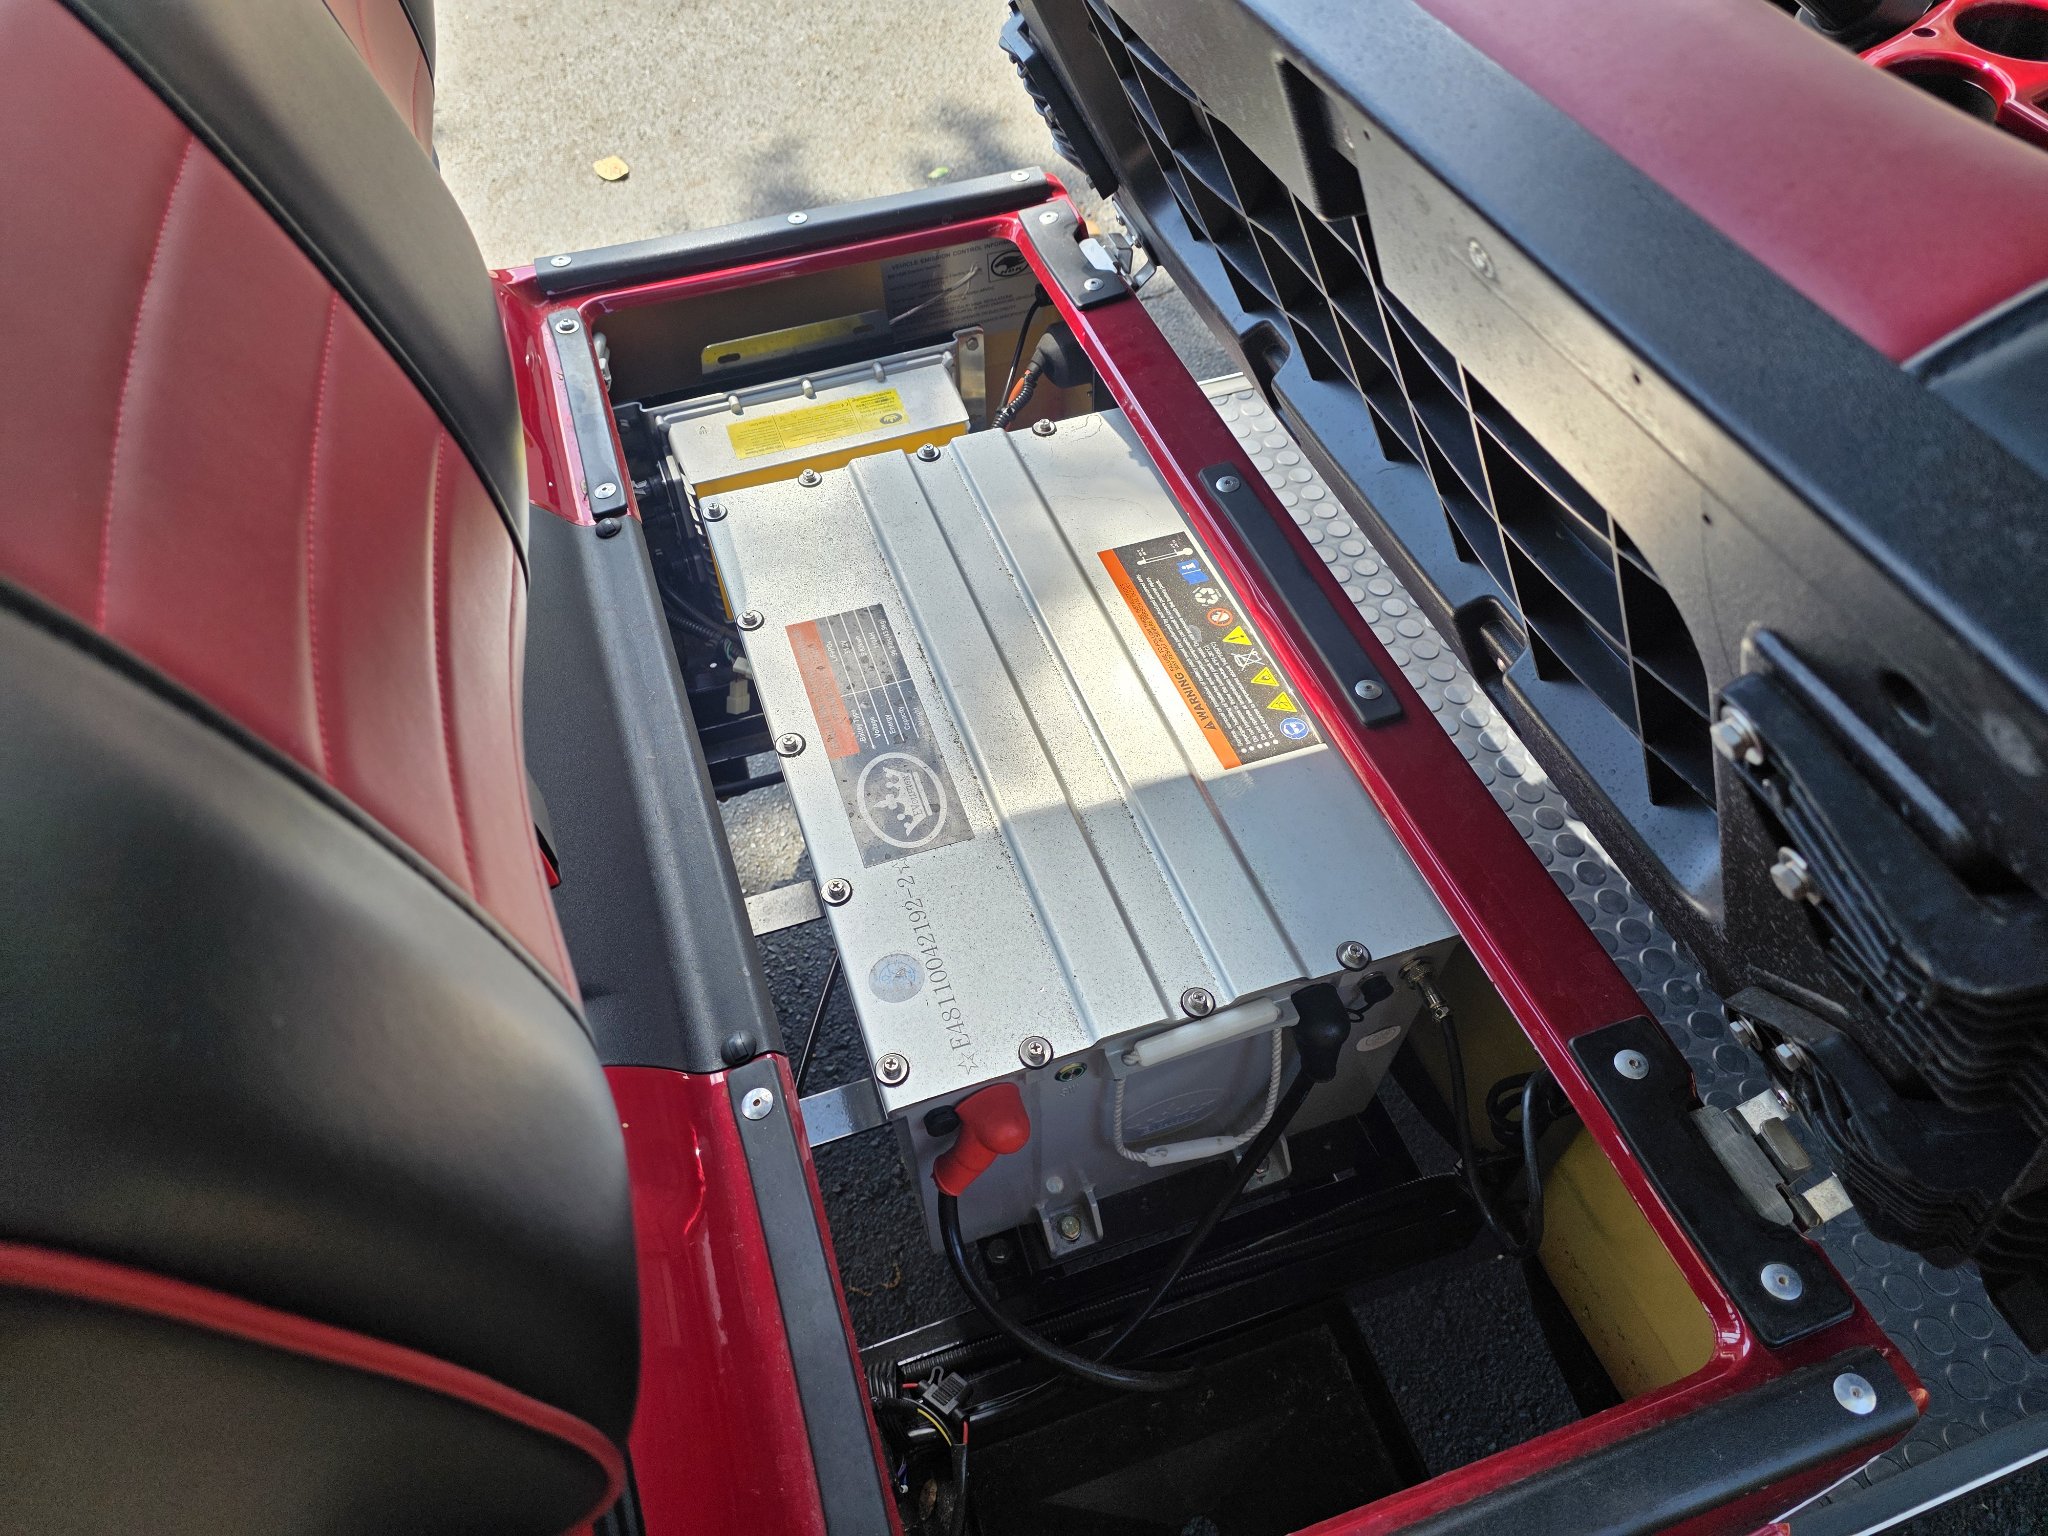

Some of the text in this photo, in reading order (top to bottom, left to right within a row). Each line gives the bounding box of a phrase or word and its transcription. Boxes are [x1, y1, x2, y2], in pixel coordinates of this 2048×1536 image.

[920, 253, 951, 264] EMISSION
[953, 244, 983, 257] CONTROL
[1172, 671, 1210, 721] WARNING
[867, 715, 883, 738] Voltage
[882, 712, 897, 734] Energy
[896, 705, 912, 730] Capacity
[911, 705, 926, 726] Weight
